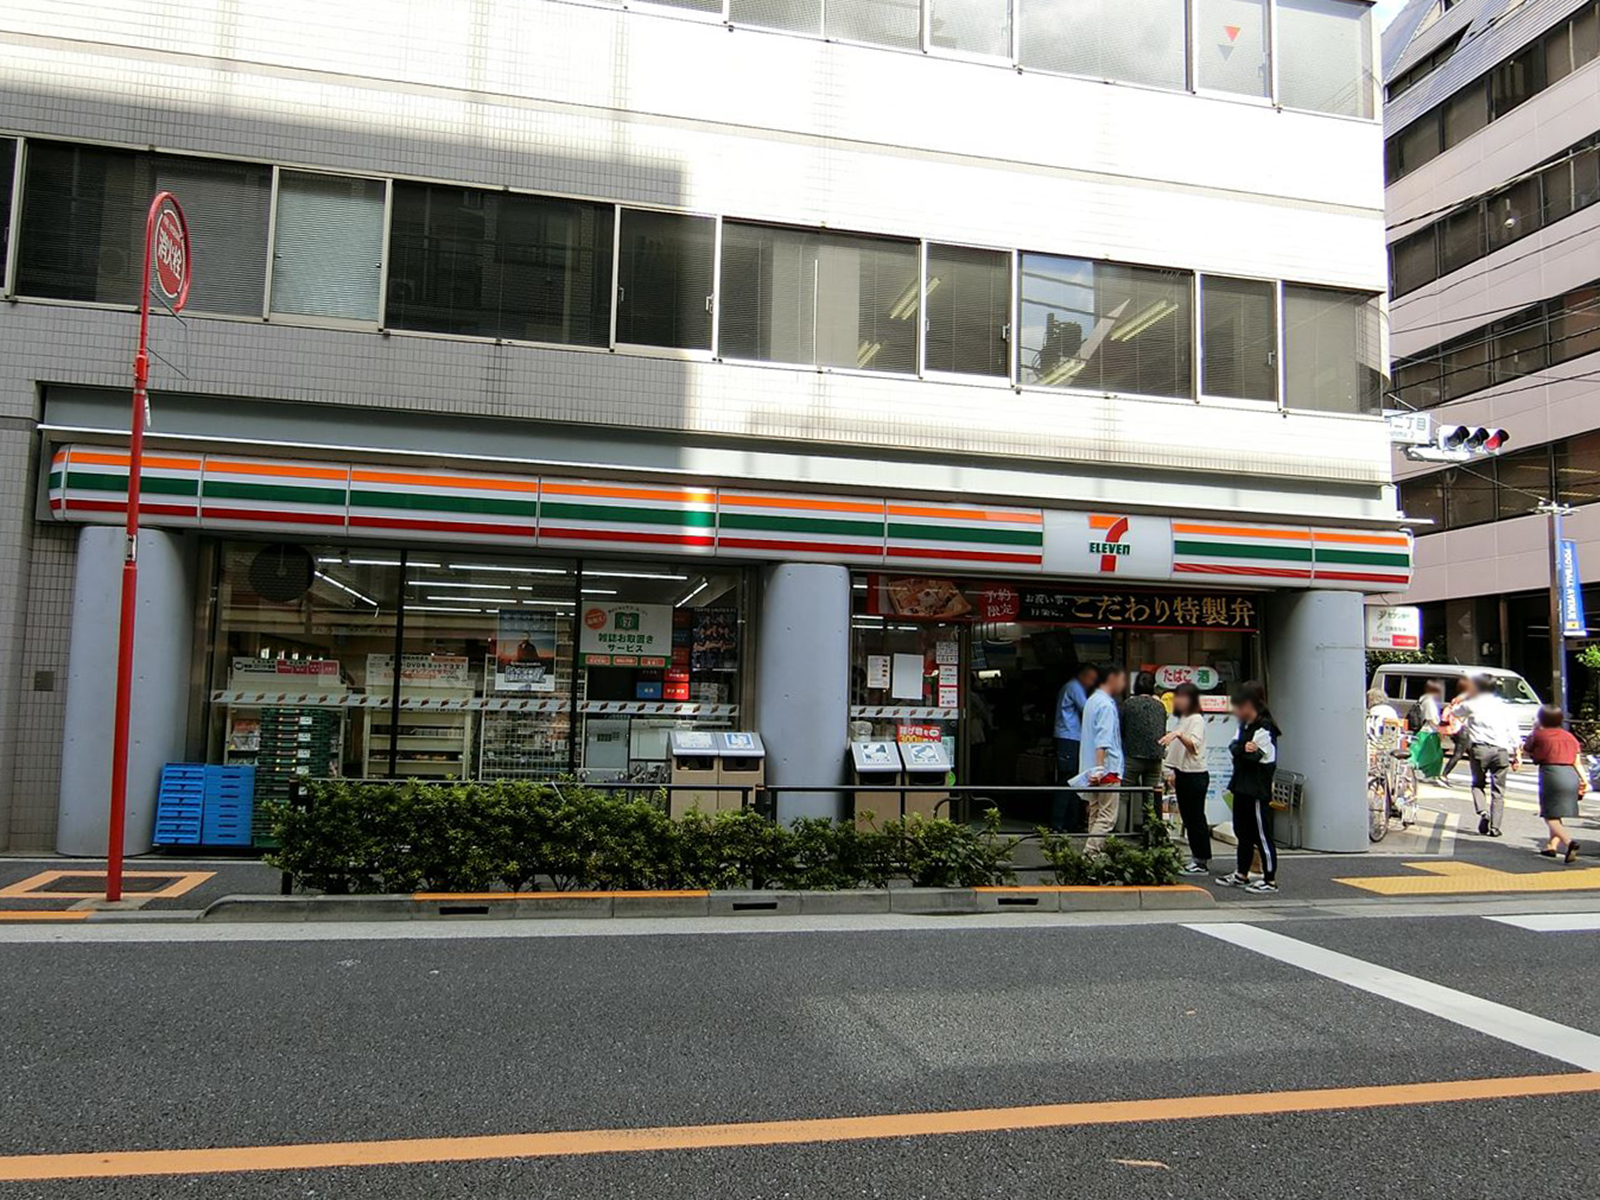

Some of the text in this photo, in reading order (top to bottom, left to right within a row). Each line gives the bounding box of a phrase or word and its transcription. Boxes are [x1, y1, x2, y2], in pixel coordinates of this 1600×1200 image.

[1390, 416, 1426, 431] 二丁目
[984, 588, 1012, 603] 予約
[986, 603, 1016, 618] 限定
[1071, 595, 1256, 627] こだわり特製弁
[1566, 588, 1577, 620] AVENUE
[598, 632, 654, 644] 雑誌お取置き
[607, 644, 644, 653] サービス
[1163, 668, 1210, 684] たばこ 酒
